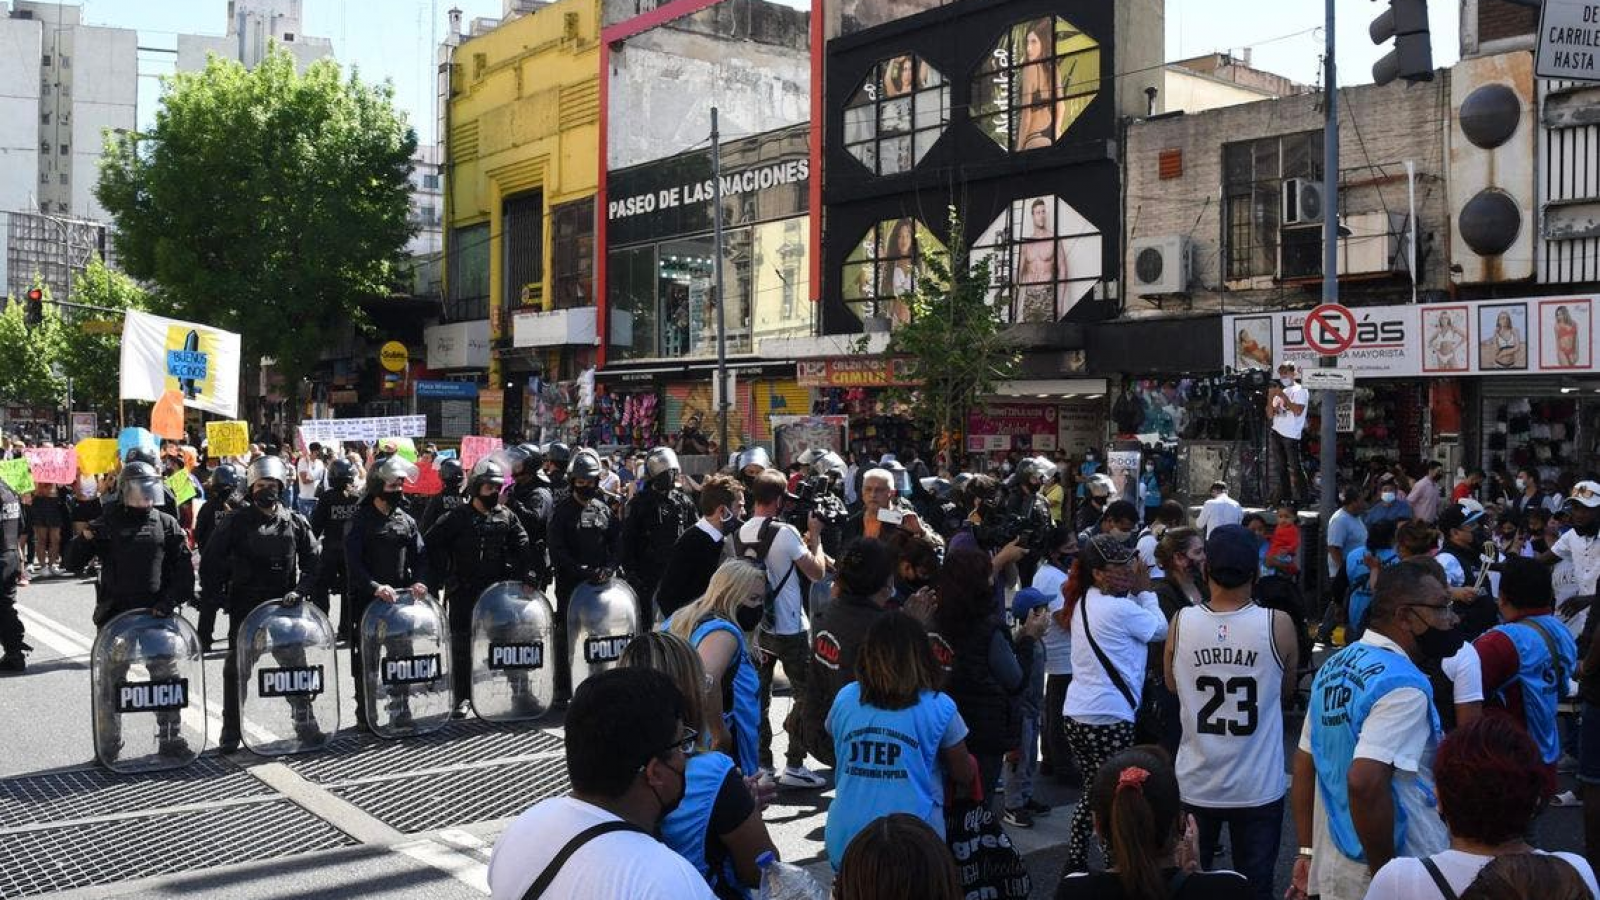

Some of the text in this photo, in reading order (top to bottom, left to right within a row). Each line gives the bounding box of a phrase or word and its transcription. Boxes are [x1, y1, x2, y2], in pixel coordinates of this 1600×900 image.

[1582, 5, 1600, 23] DE
[1553, 51, 1594, 70] HASTA
[608, 159, 809, 219] PASEO DE LAS NACIONES
[1352, 349, 1405, 359] MAYORISTA
[590, 637, 629, 660] POLIC
[1193, 648, 1258, 668] JORDAN
[1195, 676, 1258, 736] 23
